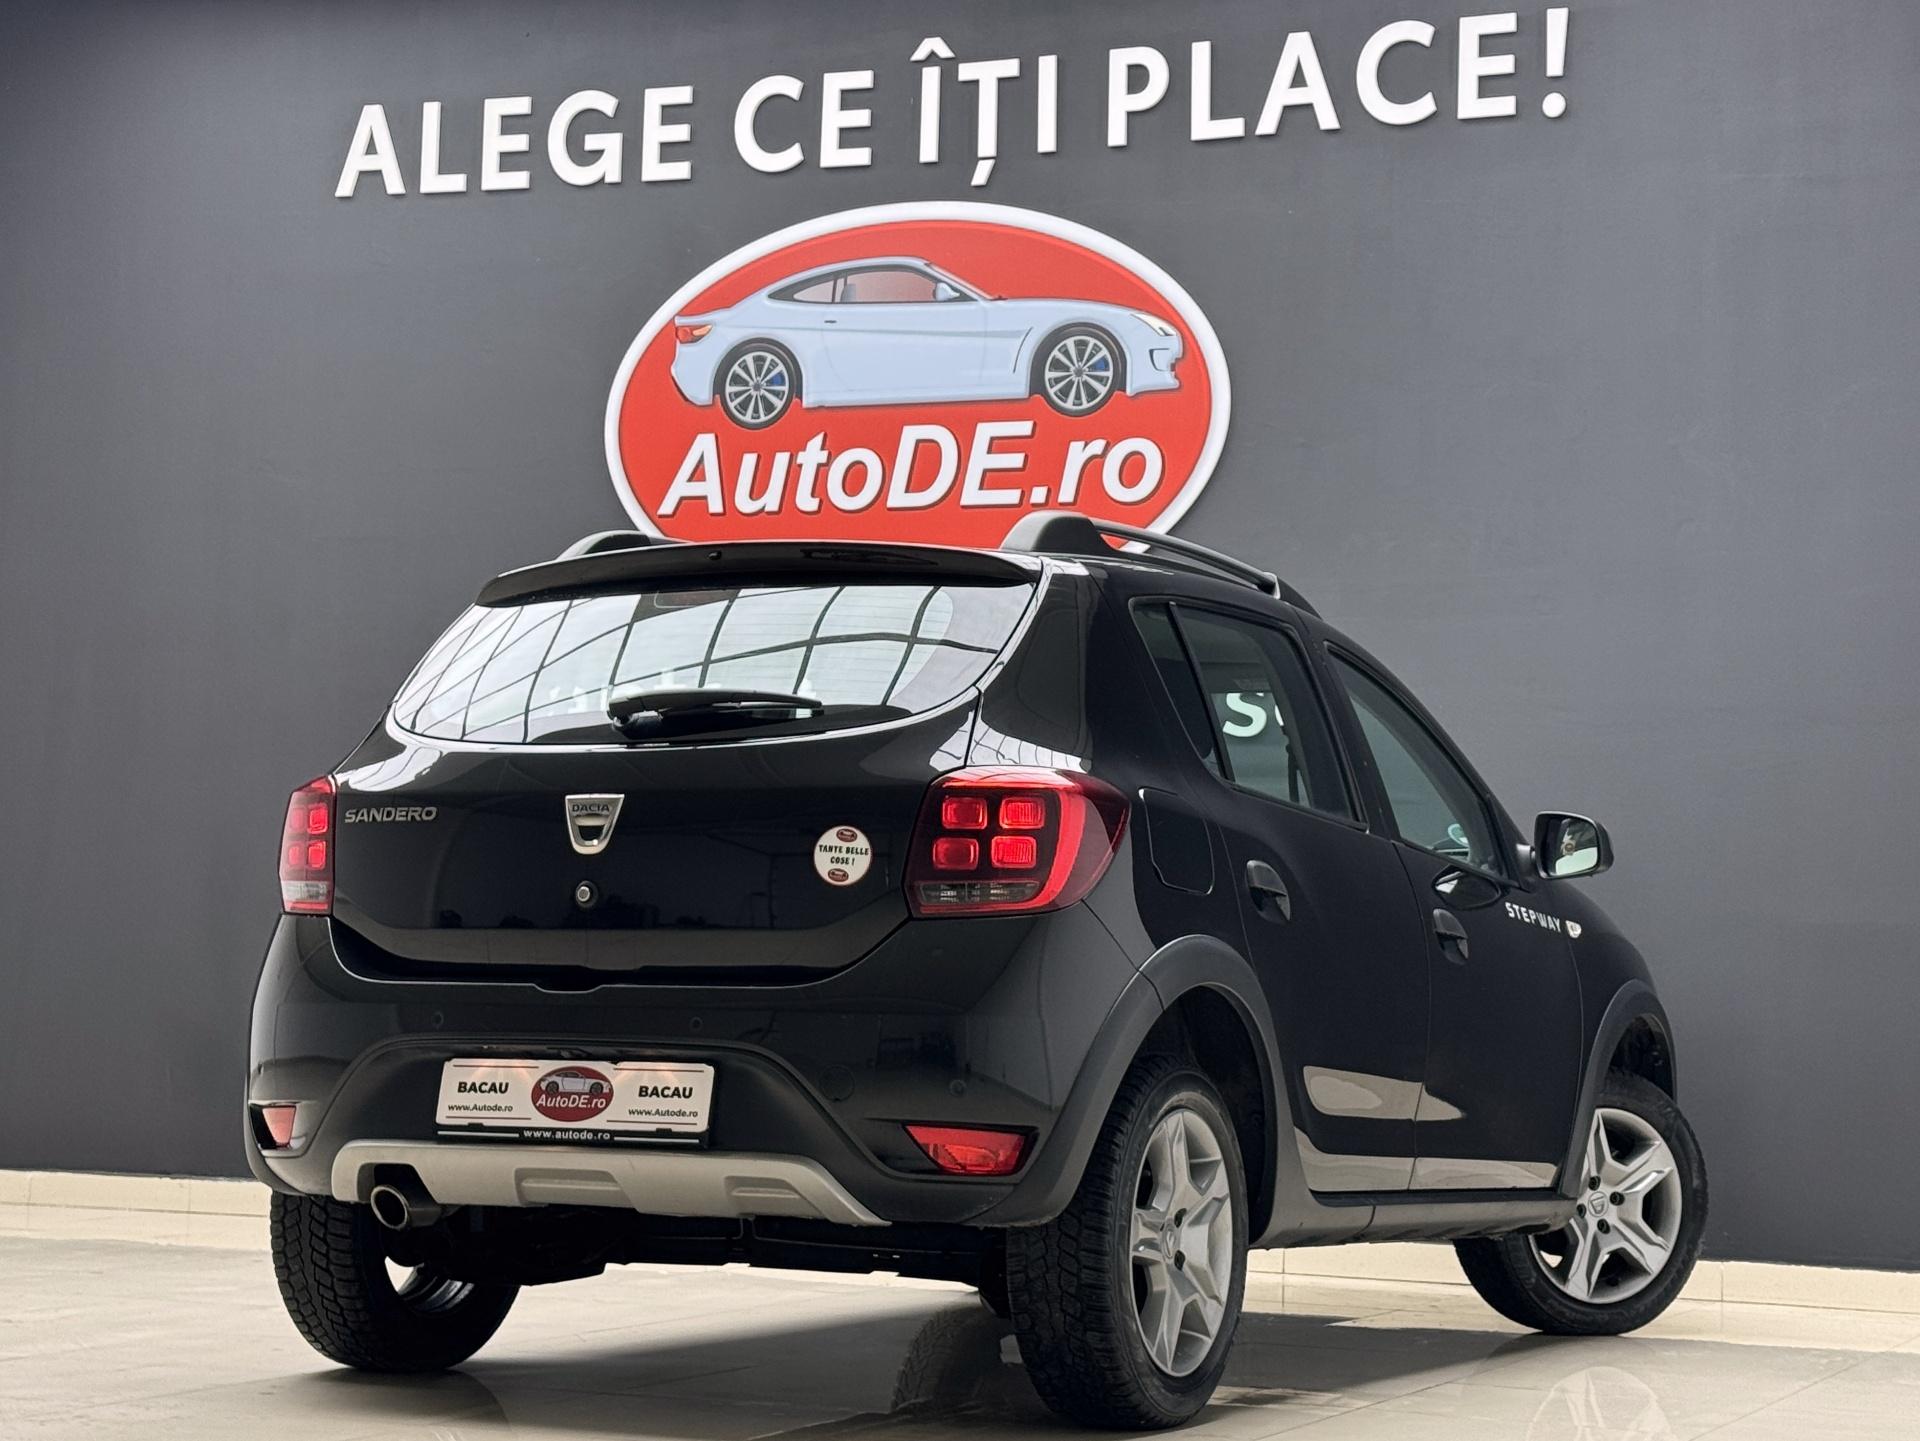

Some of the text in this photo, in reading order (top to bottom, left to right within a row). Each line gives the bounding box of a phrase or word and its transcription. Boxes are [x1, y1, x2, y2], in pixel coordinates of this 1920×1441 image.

[334, 7, 1569, 197] ALEGE CE ÎȚI PLACE!
[657, 419, 1166, 517] AutoDE.ro
[571, 803, 610, 813] DACIA
[344, 806, 438, 825] SANDERO
[819, 845, 869, 855] TANTE BELLE
[830, 857, 849, 865] COSE
[1505, 901, 1562, 933] STEPWAY
[457, 1081, 510, 1094] BACAU
[638, 1085, 694, 1099] BACAU
[536, 1093, 607, 1109] AutoDE.ro
[447, 1103, 514, 1113] www.Autode.ro
[628, 1107, 699, 1118] www.Autode.ro
[523, 1128, 612, 1141] www.autode.ro
